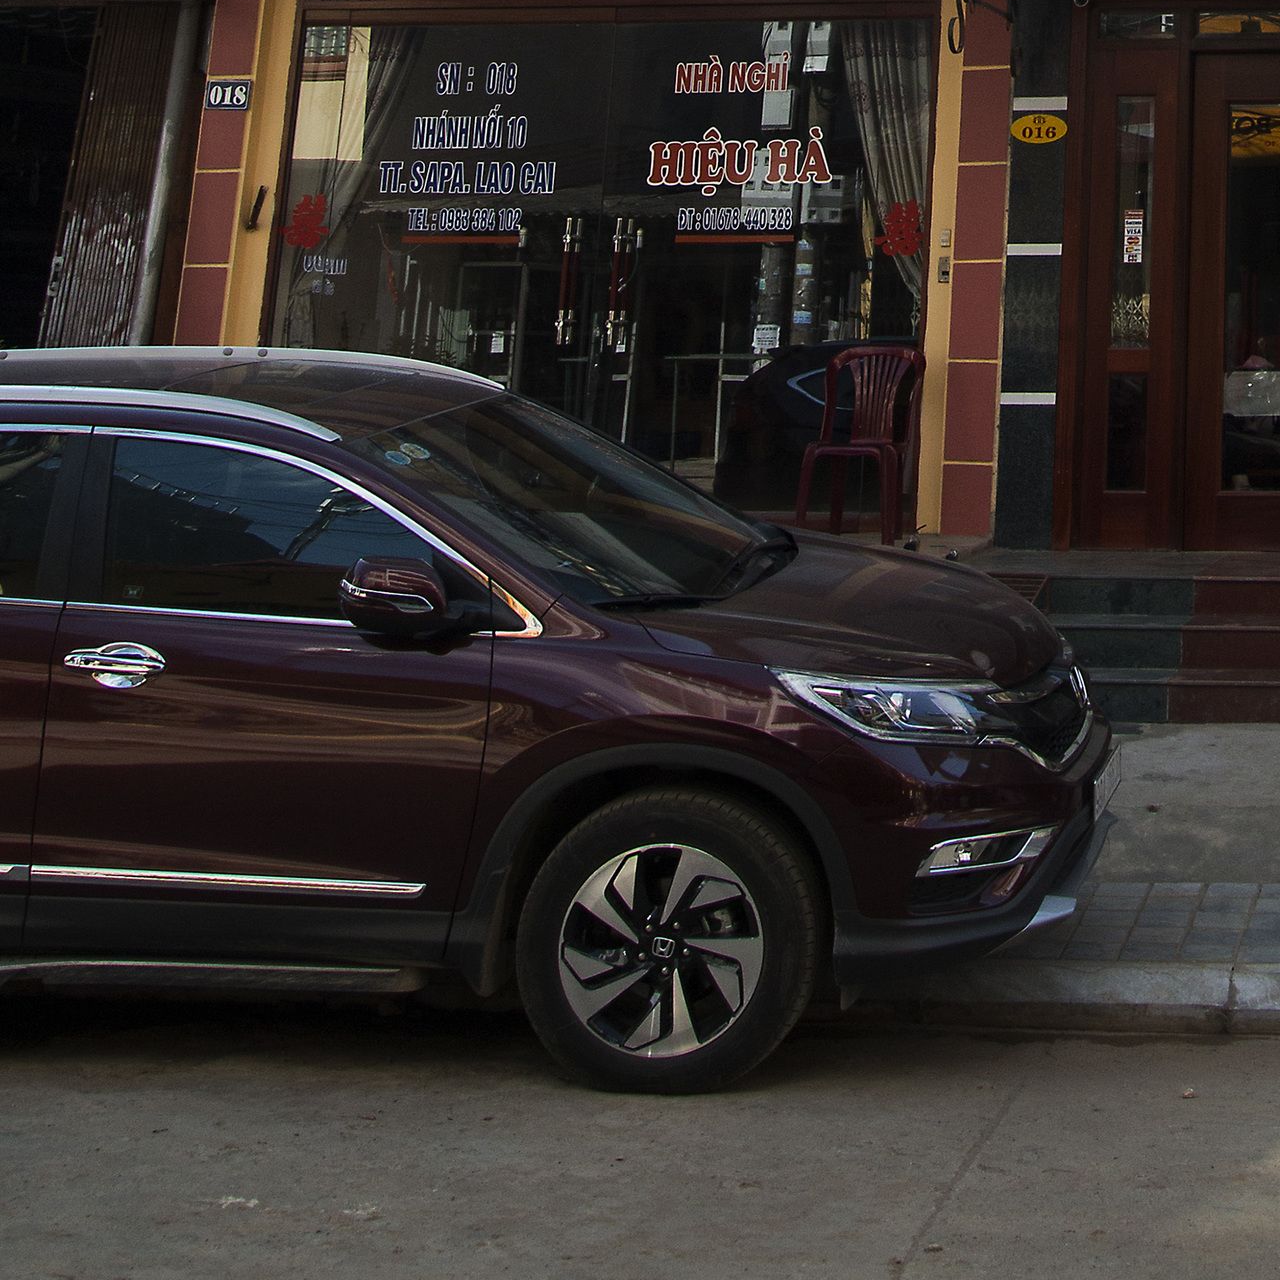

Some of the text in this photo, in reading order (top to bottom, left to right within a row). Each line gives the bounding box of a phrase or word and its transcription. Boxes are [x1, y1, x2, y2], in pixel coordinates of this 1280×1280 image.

[485, 62, 518, 95] 018
[674, 50, 791, 94] NHÀ NGHỈ
[209, 85, 247, 105] 018
[412, 104, 528, 150] NHÁNH NỐI 10
[1021, 126, 1057, 139] 016
[379, 160, 556, 195] TT. SAPA. LAO CAI
[647, 126, 833, 197] HIỆU HÀ
[438, 207, 470, 231] 0983
[471, 207, 496, 231] 384
[499, 208, 523, 231] 102
[702, 207, 740, 231] 01678
[743, 207, 768, 231] 440
[768, 207, 793, 231] 328
